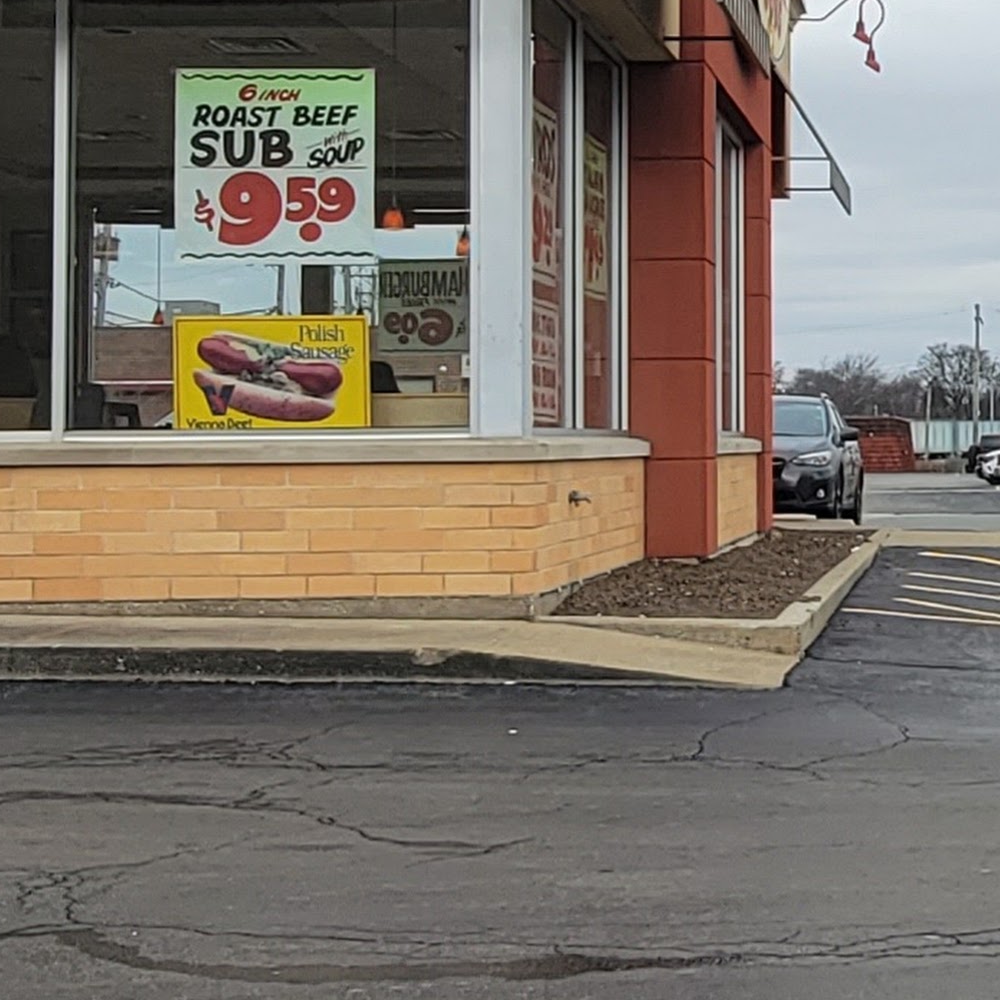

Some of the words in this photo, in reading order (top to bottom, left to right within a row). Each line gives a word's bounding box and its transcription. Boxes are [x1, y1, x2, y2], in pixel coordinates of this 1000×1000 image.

[258, 88, 301, 101] INCH
[192, 104, 282, 127] ROAST
[292, 105, 358, 126] BEEF
[190, 129, 294, 168] SUB
[307, 137, 365, 168] SOUP
[299, 324, 345, 342] Polish
[290, 342, 355, 364] Sausage
